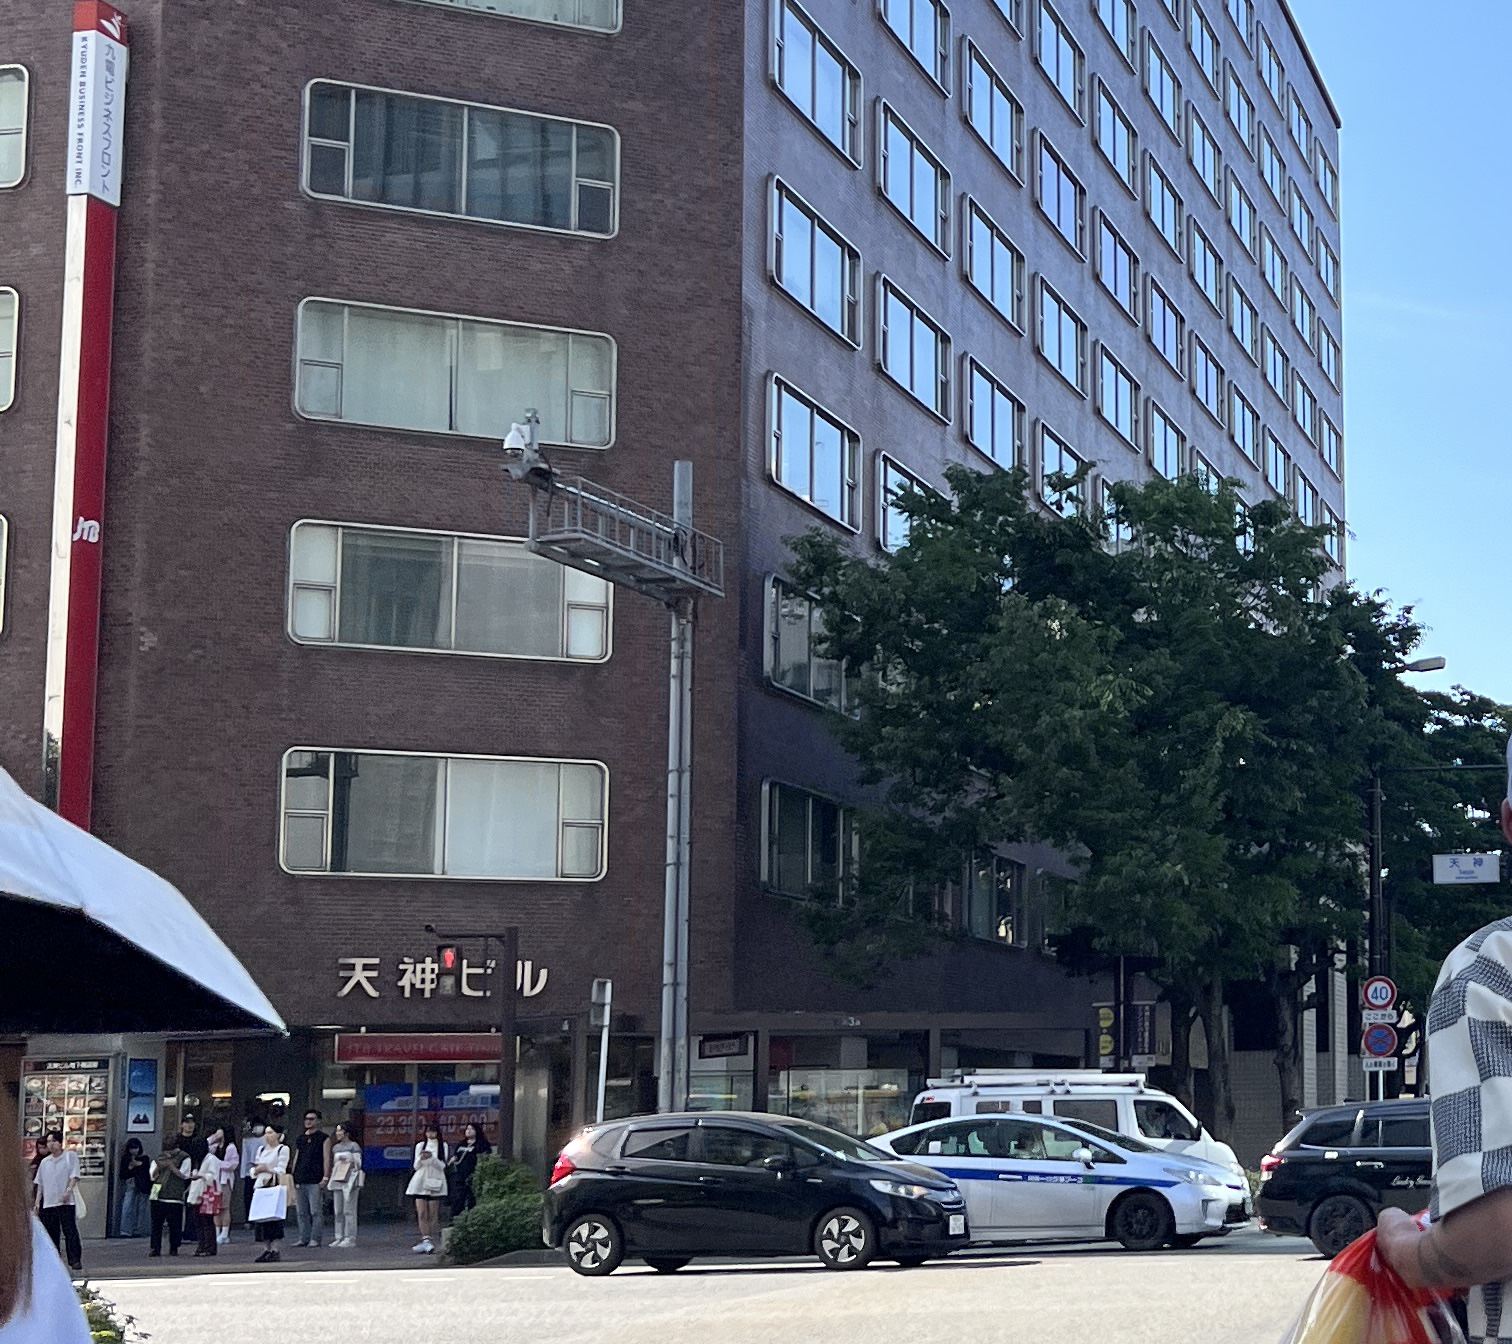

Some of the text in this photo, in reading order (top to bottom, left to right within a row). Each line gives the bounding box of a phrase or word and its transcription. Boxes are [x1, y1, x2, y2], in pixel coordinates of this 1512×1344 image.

[79, 36, 88, 78] KYUDEN
[77, 81, 86, 129] BUSINESS
[75, 132, 84, 164] FRONT
[337, 956, 548, 998] 天神ビル
[1371, 986, 1388, 1001] 40
